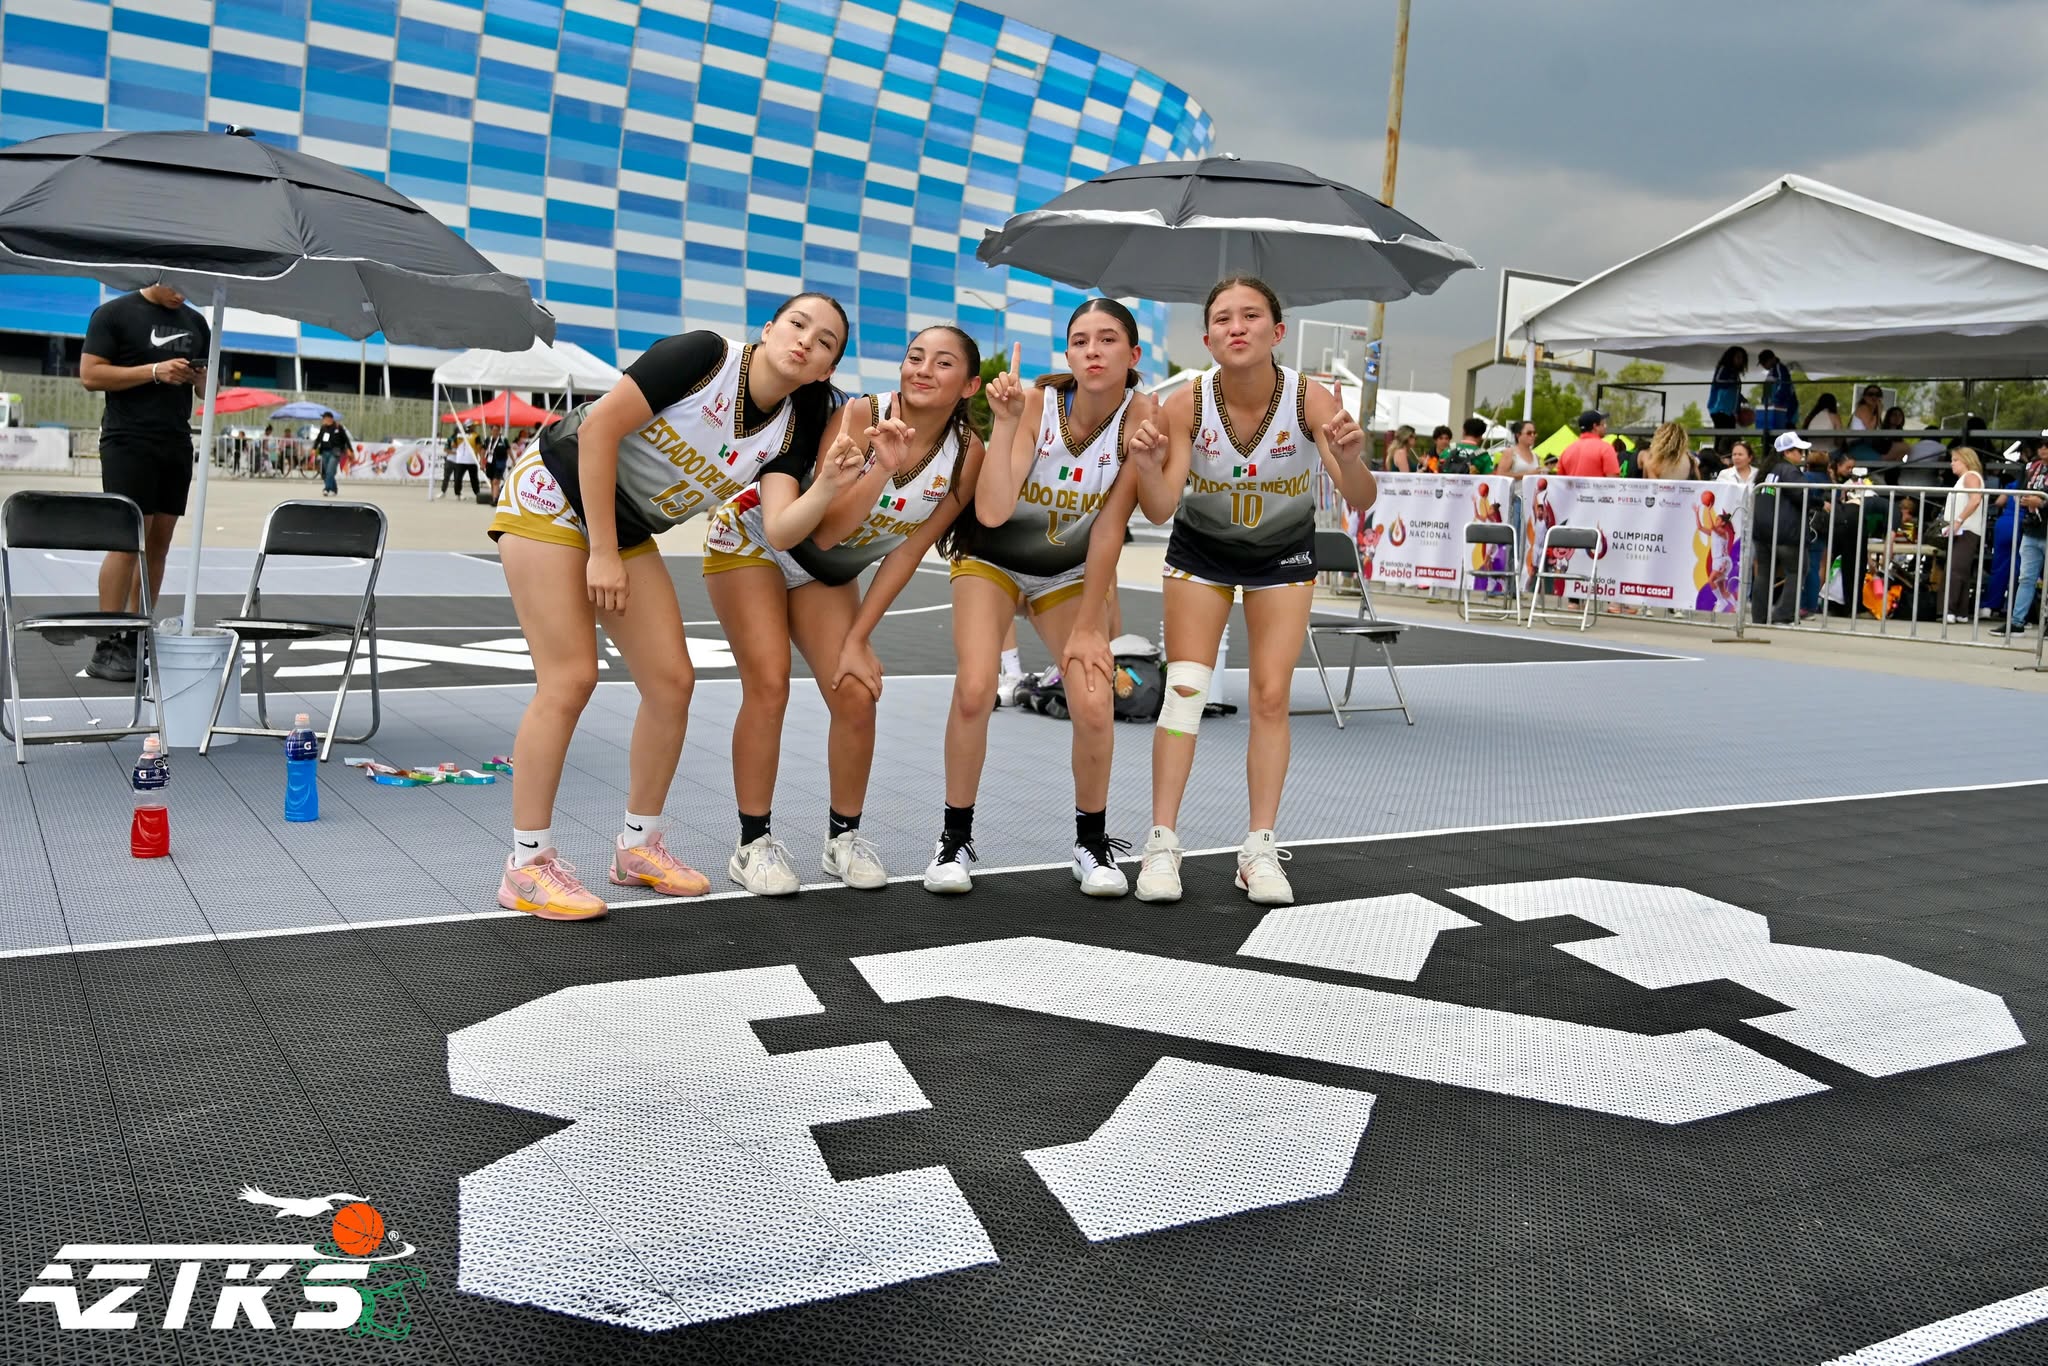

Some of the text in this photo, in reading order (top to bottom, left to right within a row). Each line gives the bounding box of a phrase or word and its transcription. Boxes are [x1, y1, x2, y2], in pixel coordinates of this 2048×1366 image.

[639, 417, 706, 475] ESTADO
[694, 463, 726, 489] DE
[1236, 482, 1257, 491] DE
[1261, 468, 1310, 497] MÉXICO
[649, 480, 705, 519] 13
[1056, 489, 1079, 511] DE
[1230, 492, 1264, 529] 10
[1410, 520, 1449, 530] OLIMPIADA
[1409, 530, 1452, 540] NACIONAL
[1612, 531, 1664, 542] OLIMPIADA
[1612, 542, 1667, 554] NACIONAL
[1379, 566, 1412, 579] Puebla
[1435, 569, 1454, 578] casa!
[1607, 577, 1616, 585] de
[1622, 585, 1671, 597] ¡es tu casa!
[304, 741, 312, 751] G
[138, 769, 147, 779] G
